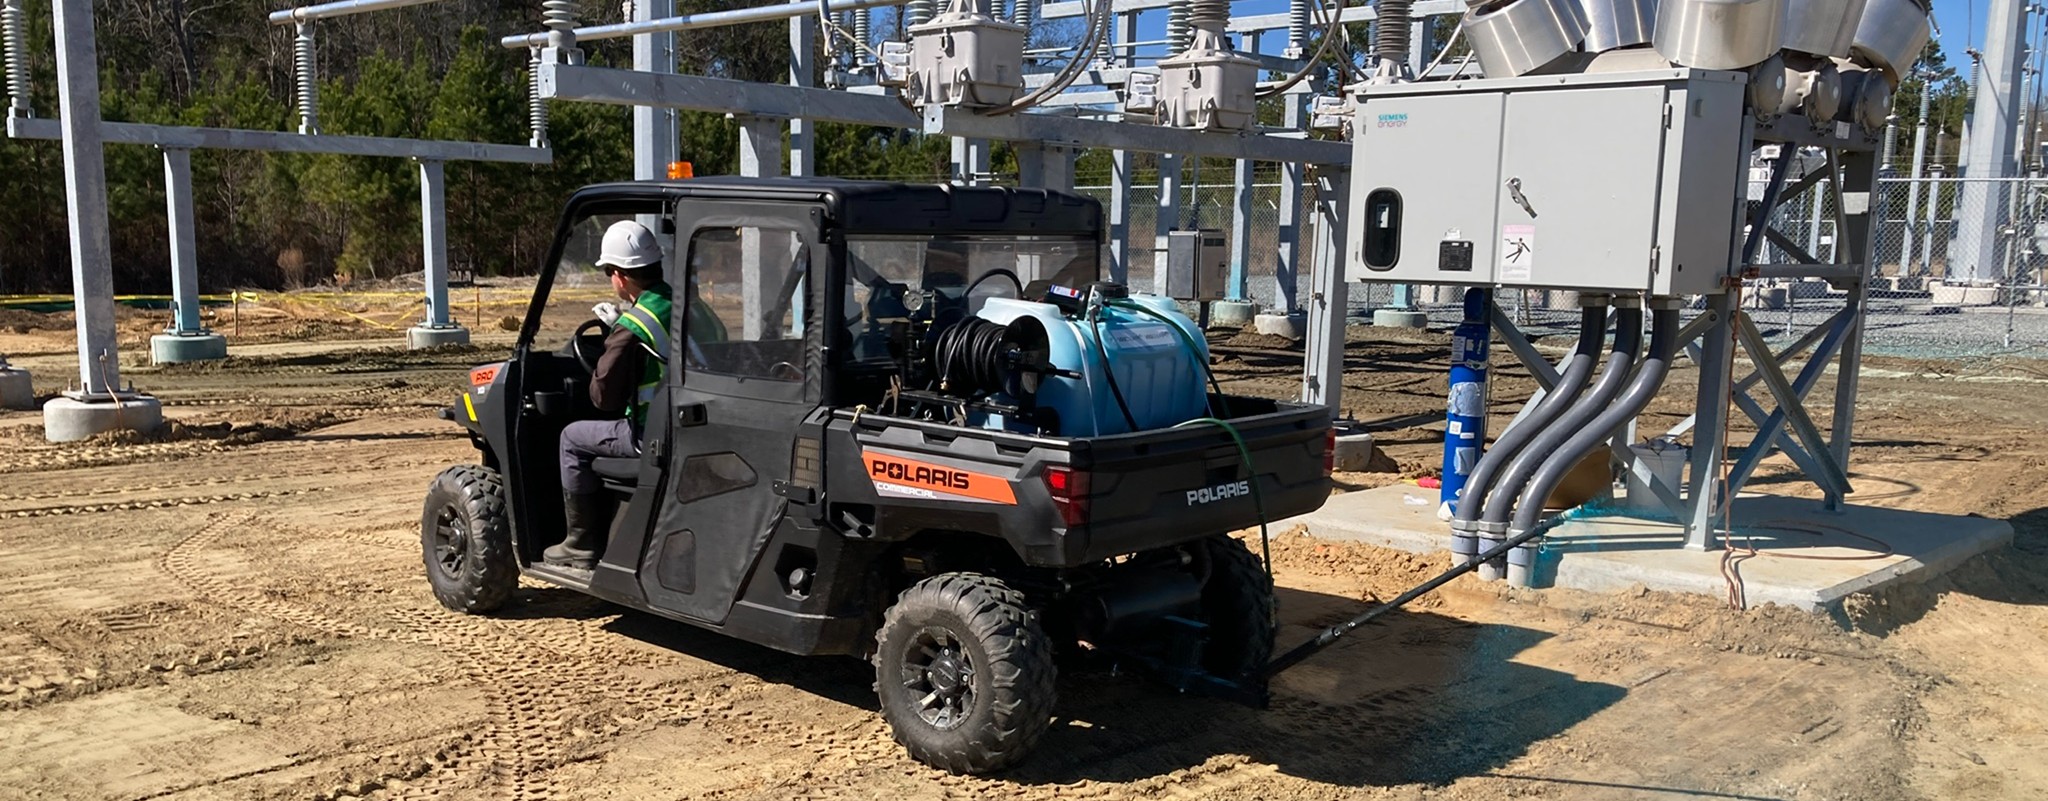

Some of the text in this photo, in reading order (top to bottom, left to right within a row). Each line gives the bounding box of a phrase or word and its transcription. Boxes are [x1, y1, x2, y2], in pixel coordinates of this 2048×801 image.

[1378, 113, 1408, 121] SIEMENS
[476, 370, 494, 382] PRO
[872, 460, 970, 490] POLARIS
[876, 481, 937, 499] COMMERCIAL
[1186, 480, 1250, 506] POLARIS
